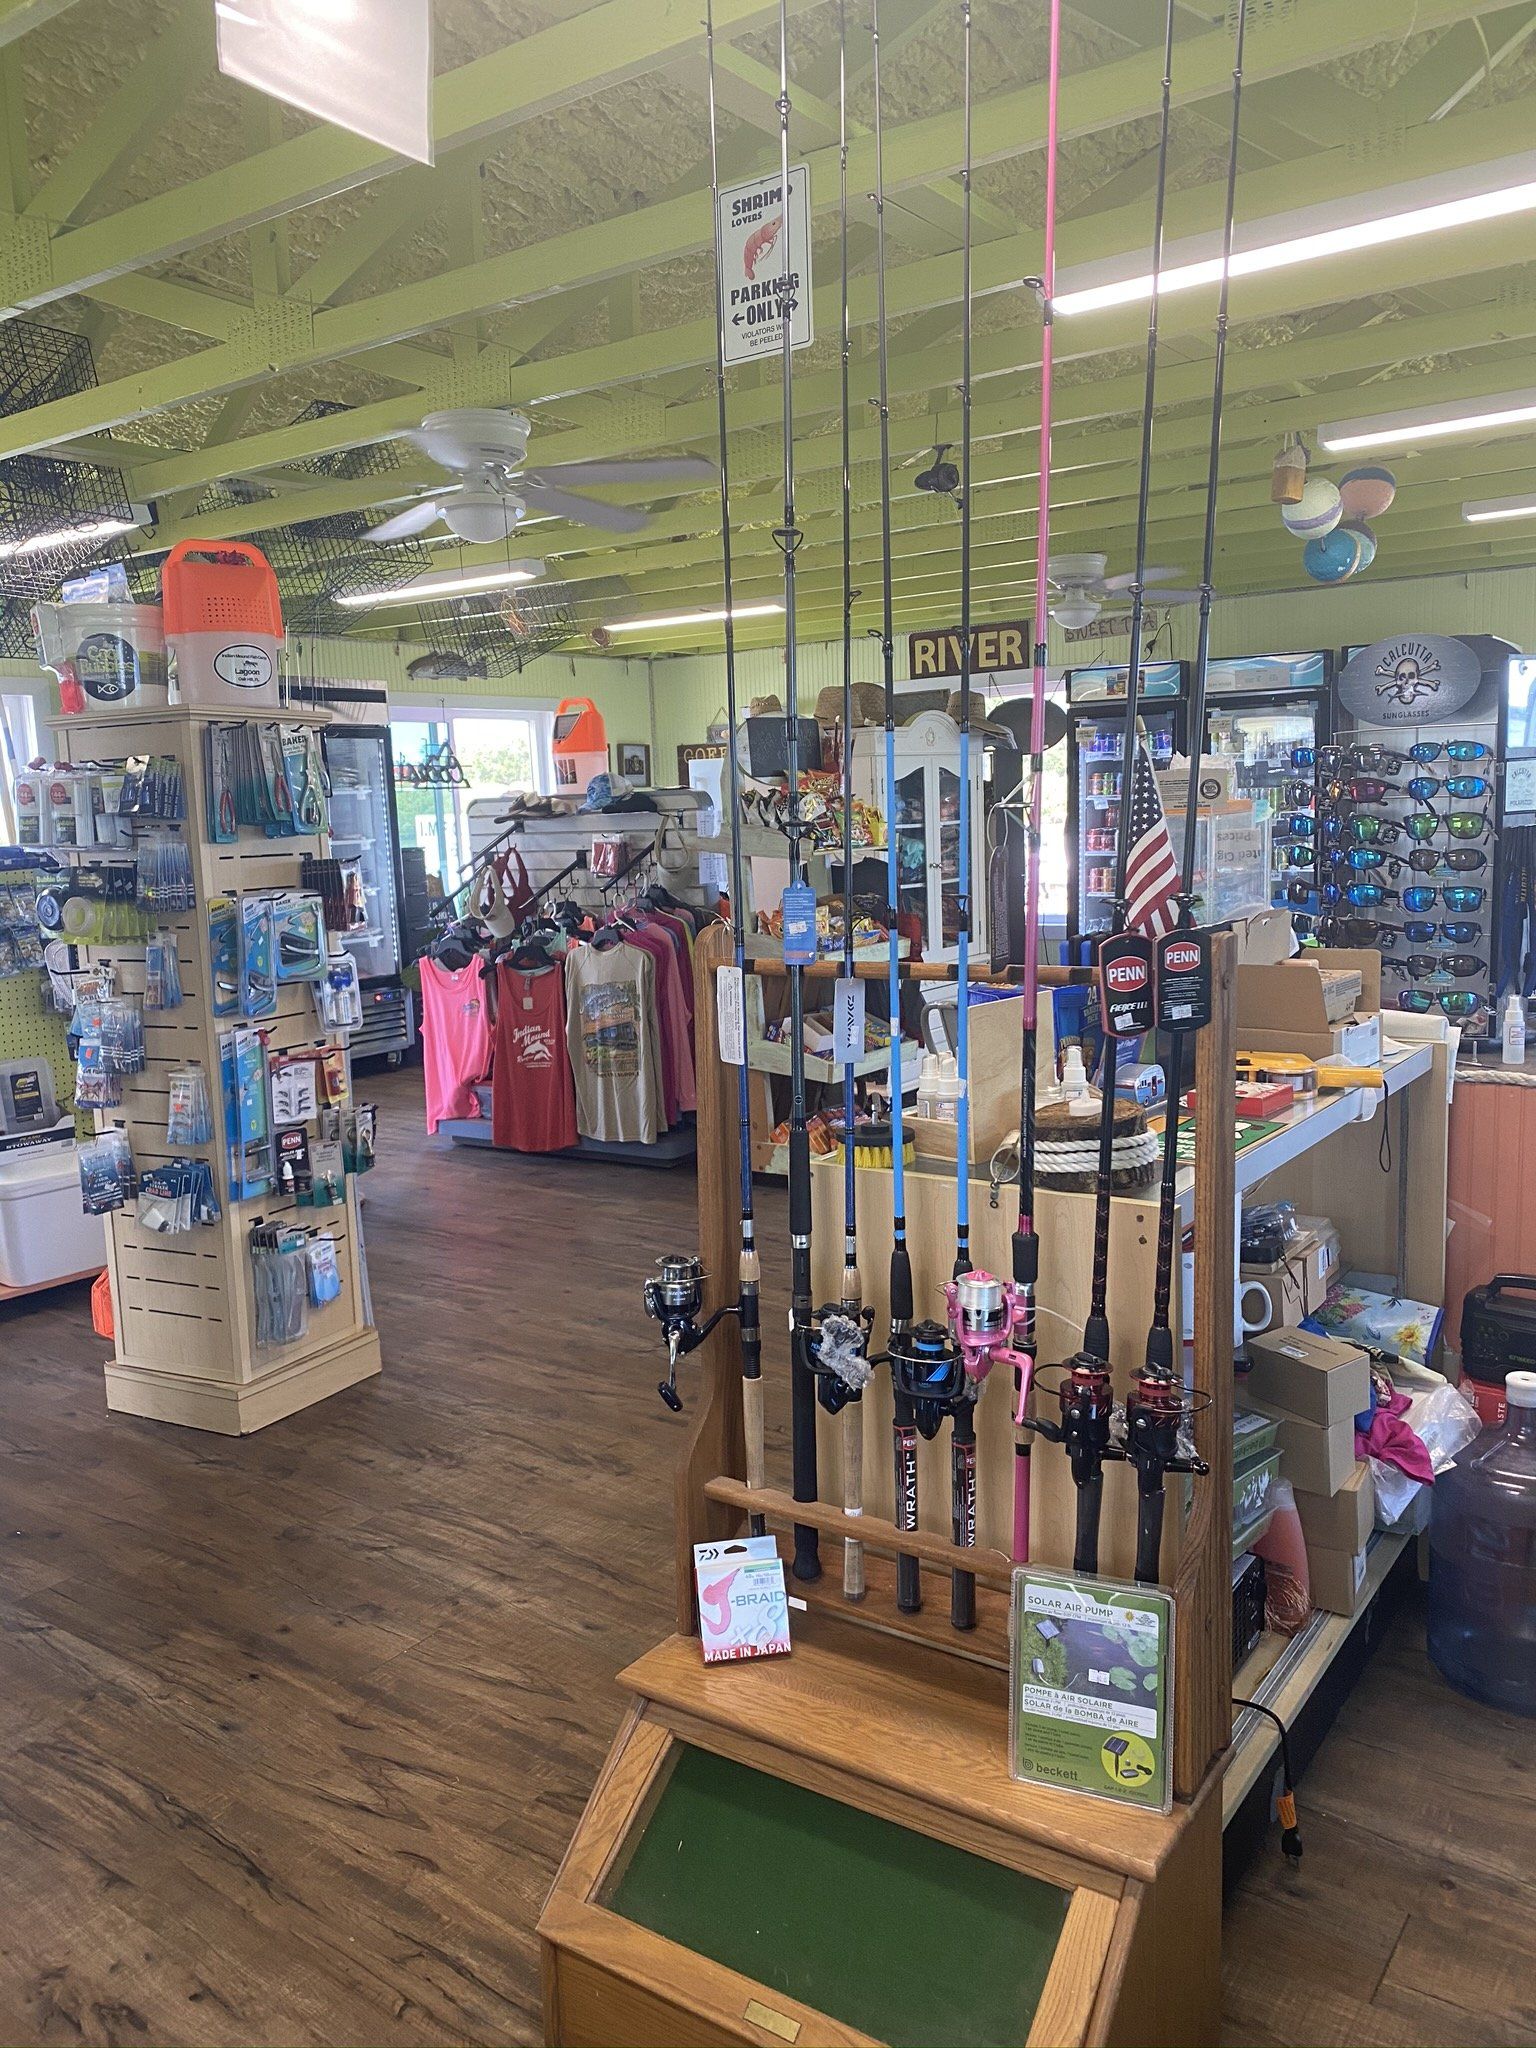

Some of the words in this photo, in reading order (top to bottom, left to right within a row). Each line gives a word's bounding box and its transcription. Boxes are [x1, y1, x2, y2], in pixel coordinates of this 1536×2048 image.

[731, 211, 762, 227] LOVERS
[746, 299, 784, 326] ONLY
[741, 325, 775, 339] VIOLATORS
[749, 338, 758, 347] BE
[759, 333, 783, 345] PEELED
[1121, 614, 1154, 632] TA
[914, 630, 1022, 674] RIVER
[1382, 642, 1433, 667] CALCUTTA
[235, 668, 260, 676] Lagoon
[1382, 710, 1430, 720] SUNGLASSES
[1217, 832, 1250, 840] Prices
[1166, 950, 1198, 965] PENN
[1109, 966, 1146, 983] PENN
[1087, 986, 1098, 1006] 24
[1110, 1002, 1137, 1014] FIERCE
[513, 1025, 541, 1044] Indian
[521, 1029, 551, 1048] Mound
[6, 1137, 52, 1150] STOWAWAY
[282, 1136, 301, 1146] PENN
[906, 1461, 916, 1530] WRATH
[968, 1479, 976, 1548] WRATH
[1028, 1596, 1062, 1608] SOLAR
[1064, 1603, 1082, 1612] AIR
[1085, 1606, 1114, 1618] PUMP
[704, 1650, 736, 1662] MADE
[740, 1646, 751, 1658] IN
[755, 1642, 792, 1656] JAPAN
[1024, 1686, 1052, 1698] POMPE
[1062, 1694, 1075, 1702] AIR
[1078, 1697, 1112, 1710] SOLAIRE
[1024, 1699, 1051, 1709] SOLAR
[1074, 1708, 1104, 1720] BOMBA
[1119, 1718, 1139, 1728] AIRE
[1036, 1763, 1078, 1780] beckett
